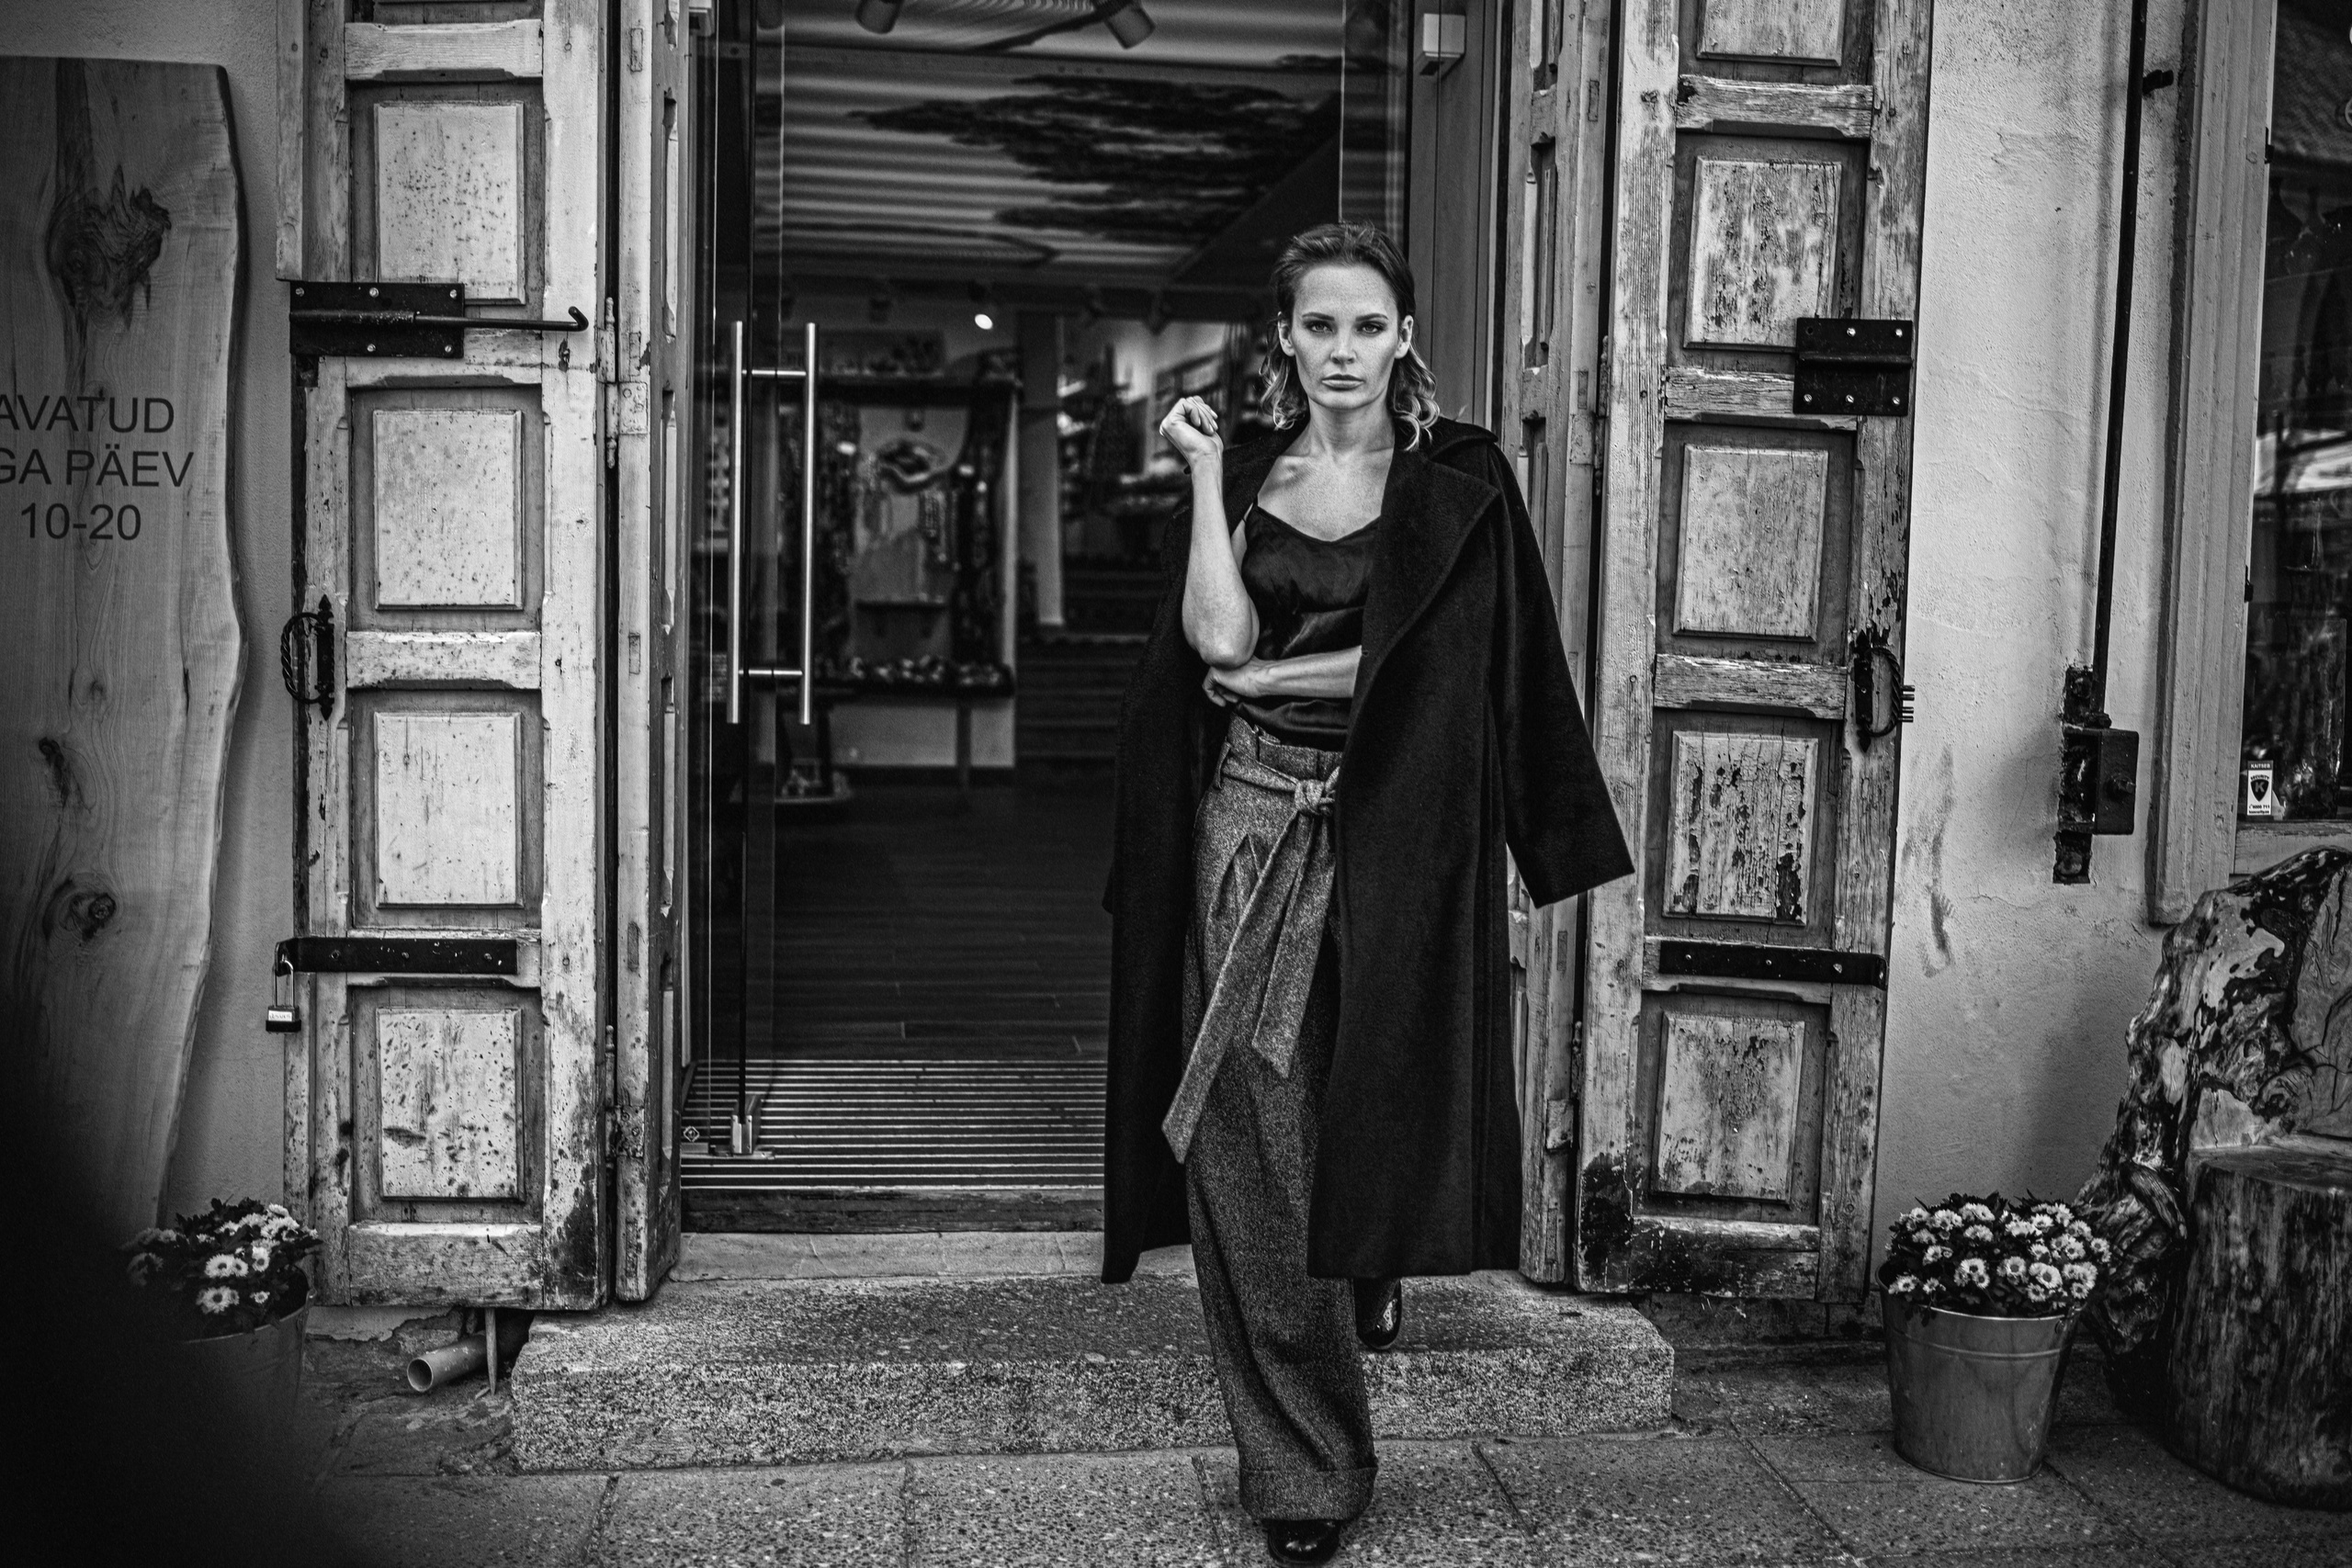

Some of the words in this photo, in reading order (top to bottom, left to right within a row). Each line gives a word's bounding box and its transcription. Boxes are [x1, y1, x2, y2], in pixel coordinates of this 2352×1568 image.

[0, 394, 175, 434] AVATUD
[66, 444, 194, 487] PÄEV
[21, 502, 141, 540] 10-20
[2255, 782, 2265, 793] K
